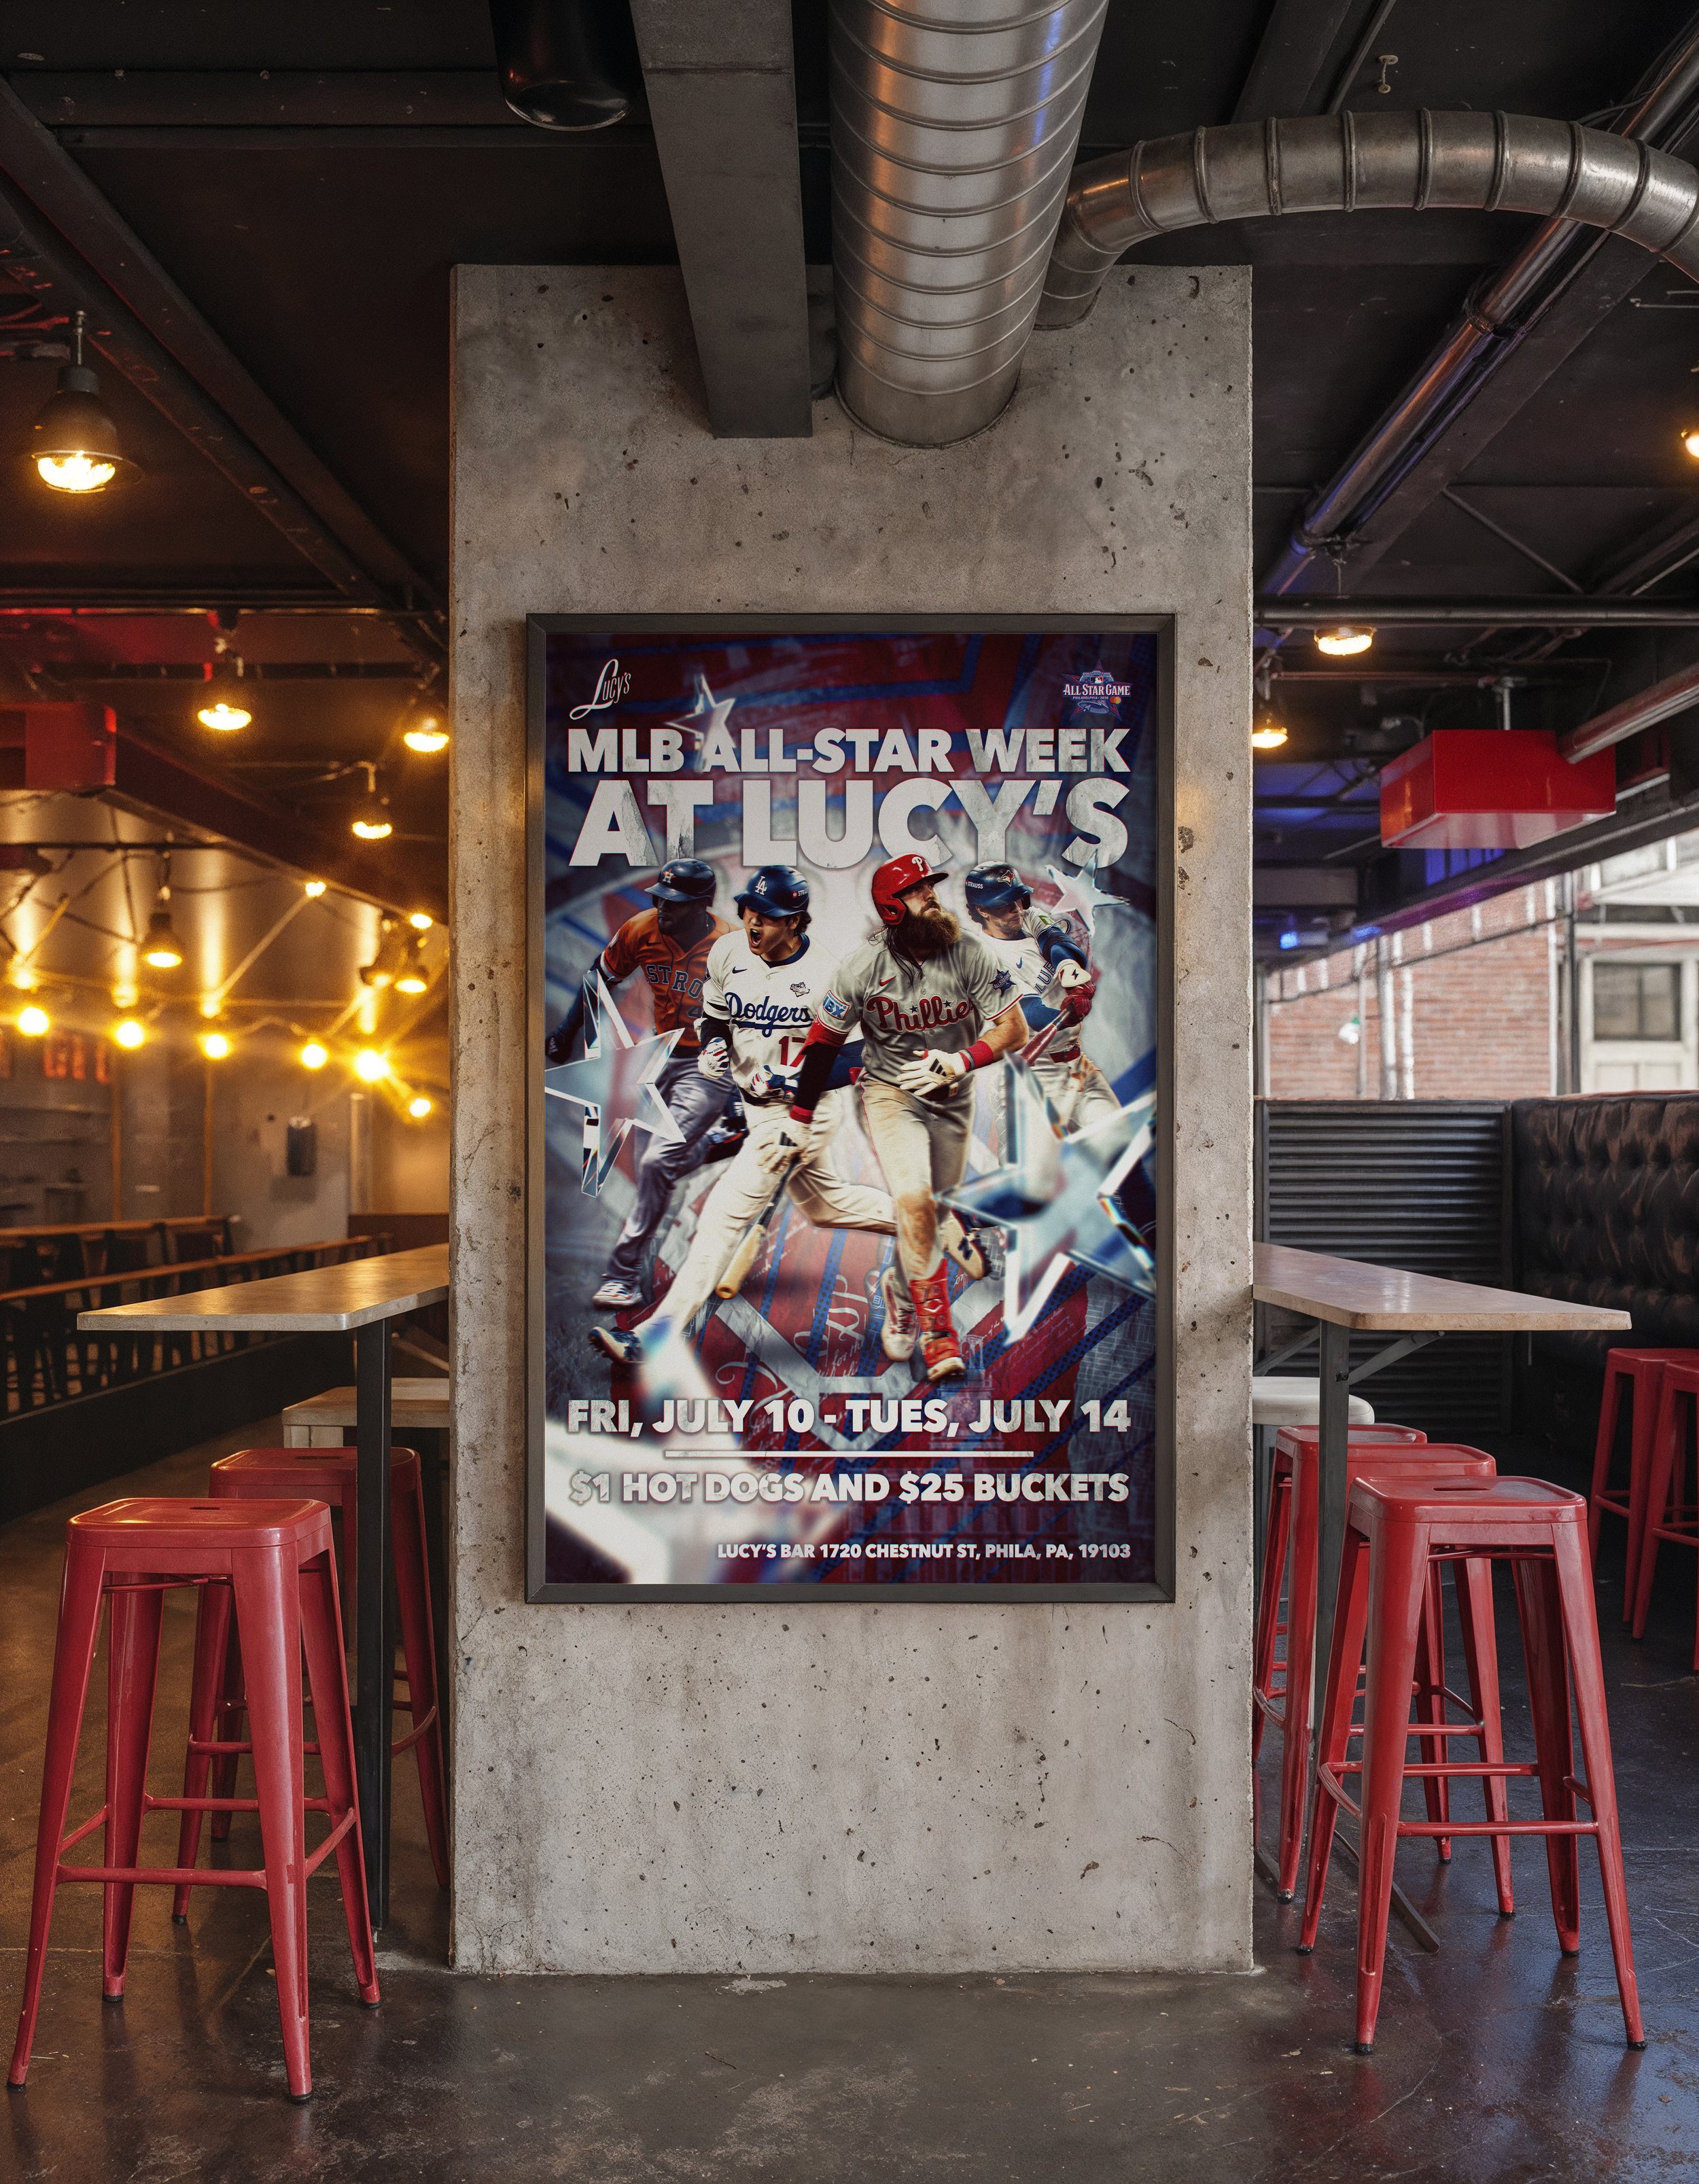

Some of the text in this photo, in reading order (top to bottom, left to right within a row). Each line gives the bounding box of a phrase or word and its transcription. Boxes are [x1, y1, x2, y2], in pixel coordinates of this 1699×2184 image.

[570, 658, 631, 720] Lucy's
[1063, 684, 1131, 696] ALL STAR GAME
[568, 727, 1131, 773] MLB ALL-STAR WEEK
[569, 778, 1131, 870] AT LUCY'S
[662, 870, 673, 883] H
[911, 856, 923, 872] P
[755, 875, 768, 896] LA
[967, 881, 983, 890] STRAUSS
[724, 991, 815, 1038] Dodgers
[822, 995, 845, 1019] IBX
[866, 995, 973, 1032] Phillie
[779, 1035, 807, 1068] 17
[568, 1400, 643, 1437] FRI,
[652, 1400, 754, 1433] JULY
[764, 1398, 815, 1433] 10
[845, 1398, 960, 1437] TUES,
[968, 1400, 1071, 1433] JULY
[1080, 1400, 1132, 1432] 14
[570, 1470, 1130, 1504] $1 HOT DOGS AND $25 BUCKETS
[718, 1544, 1132, 1560] LUCY'S BAR 1720 CHESTNUT ST, PHILA, PA, 19103
